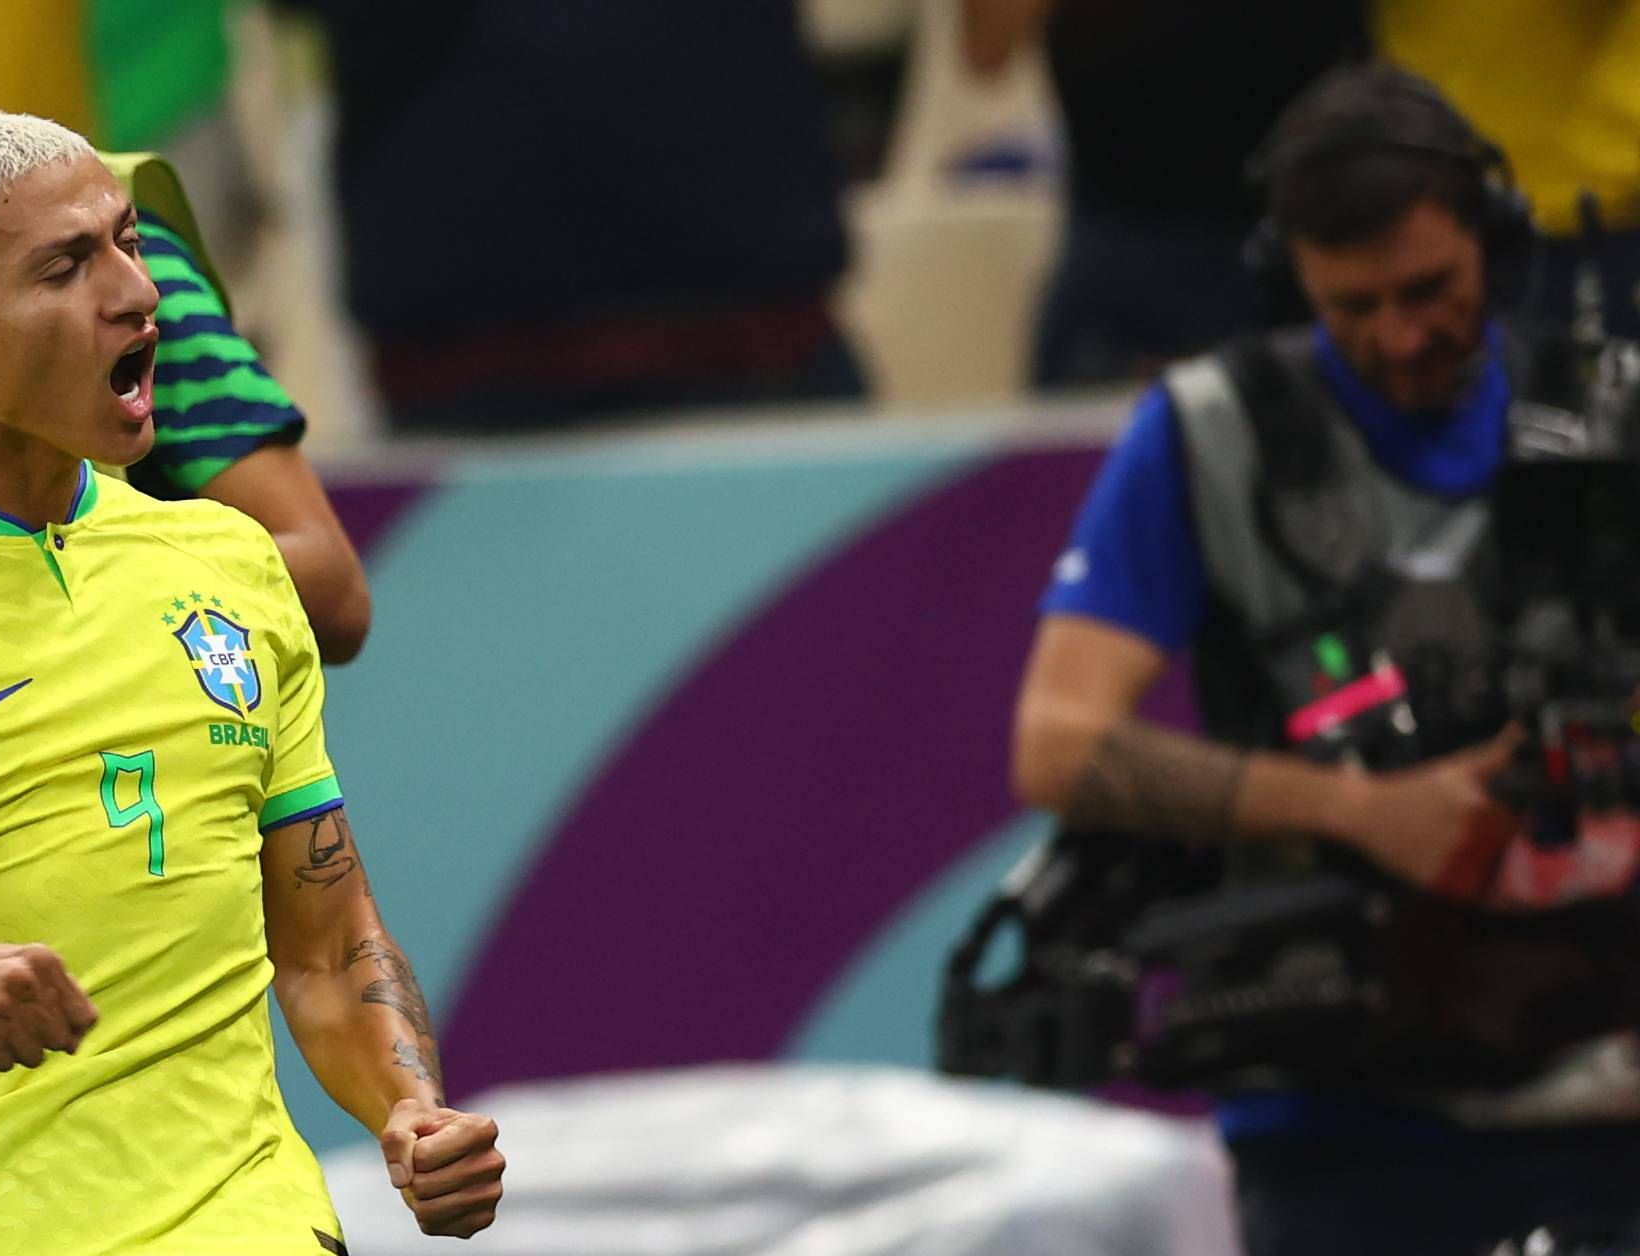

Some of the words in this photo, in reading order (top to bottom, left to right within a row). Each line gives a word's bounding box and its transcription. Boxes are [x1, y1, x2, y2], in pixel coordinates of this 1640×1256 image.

[209, 653, 237, 666] CBF
[208, 723, 270, 750] BRASIL
[99, 749, 165, 877] 9
